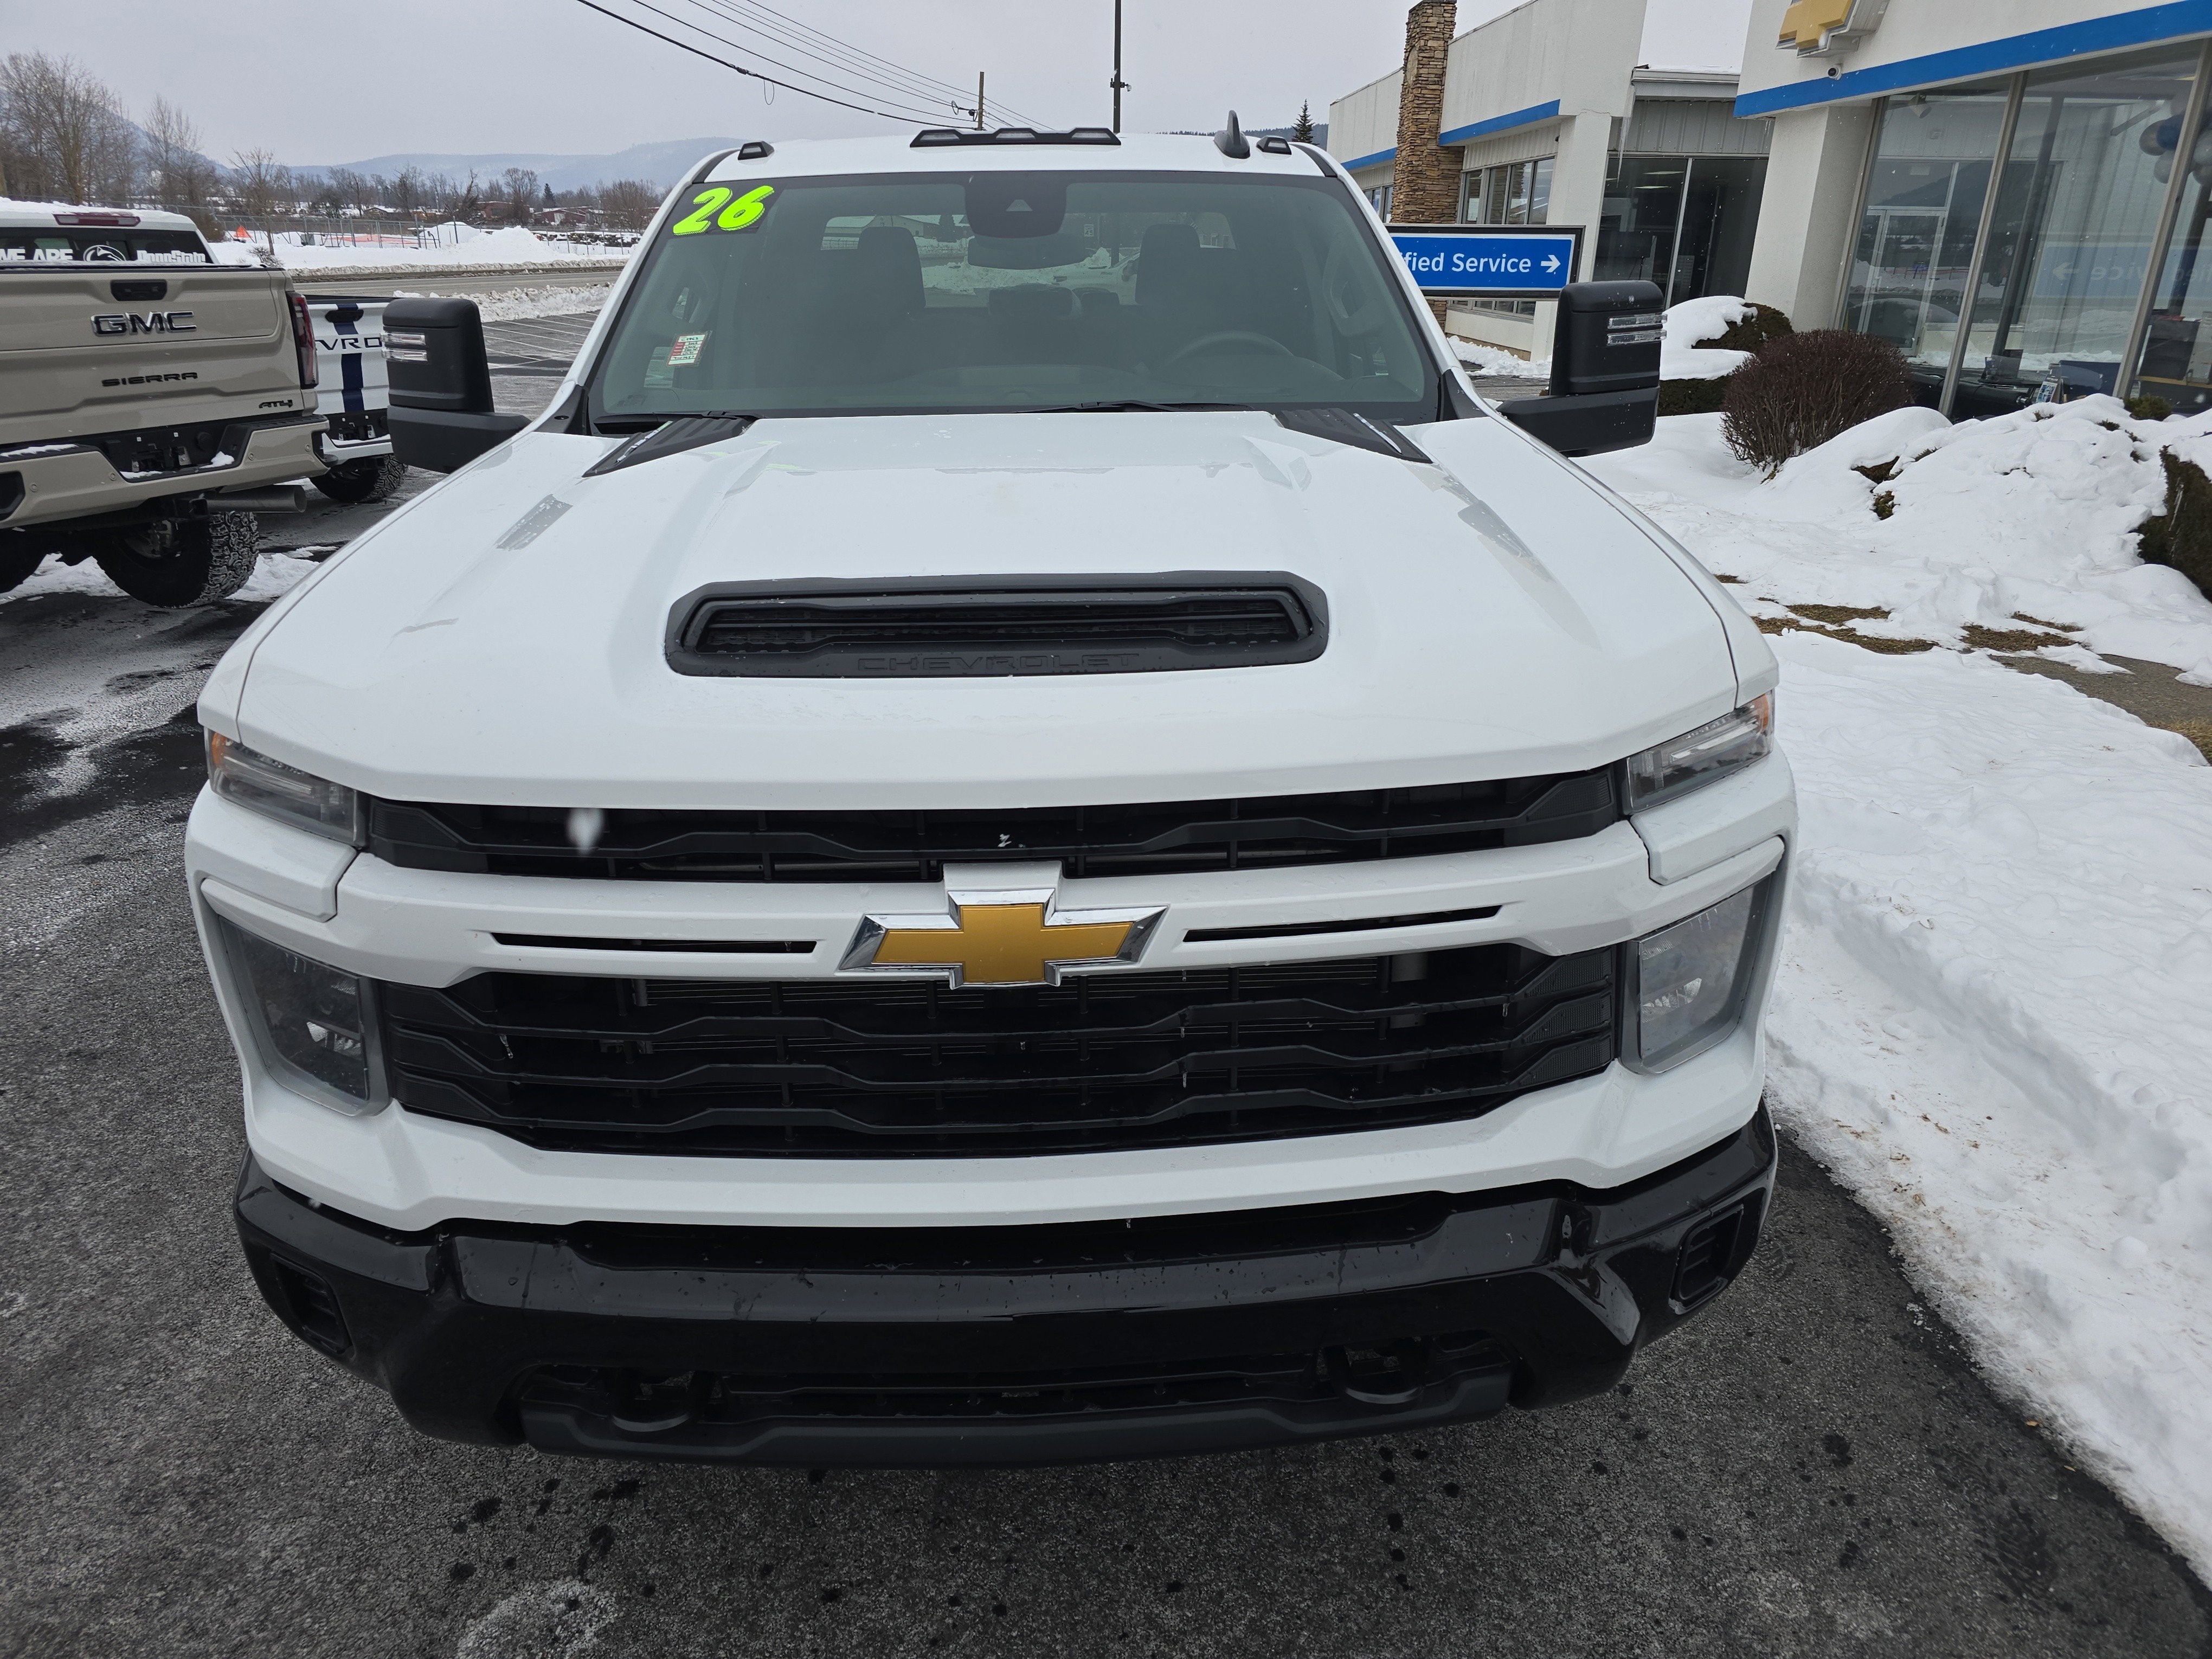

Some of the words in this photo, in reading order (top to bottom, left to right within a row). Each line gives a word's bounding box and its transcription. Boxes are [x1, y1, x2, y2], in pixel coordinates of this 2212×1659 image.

[673, 185, 774, 236] 26
[33, 248, 74, 261] ARE
[1400, 252, 1444, 272] fied
[1451, 253, 1532, 273] Service
[91, 311, 197, 337] GMC
[101, 372, 198, 387] SIERRA
[259, 399, 293, 409] AT4
[858, 653, 1140, 671] CHEVROLET
